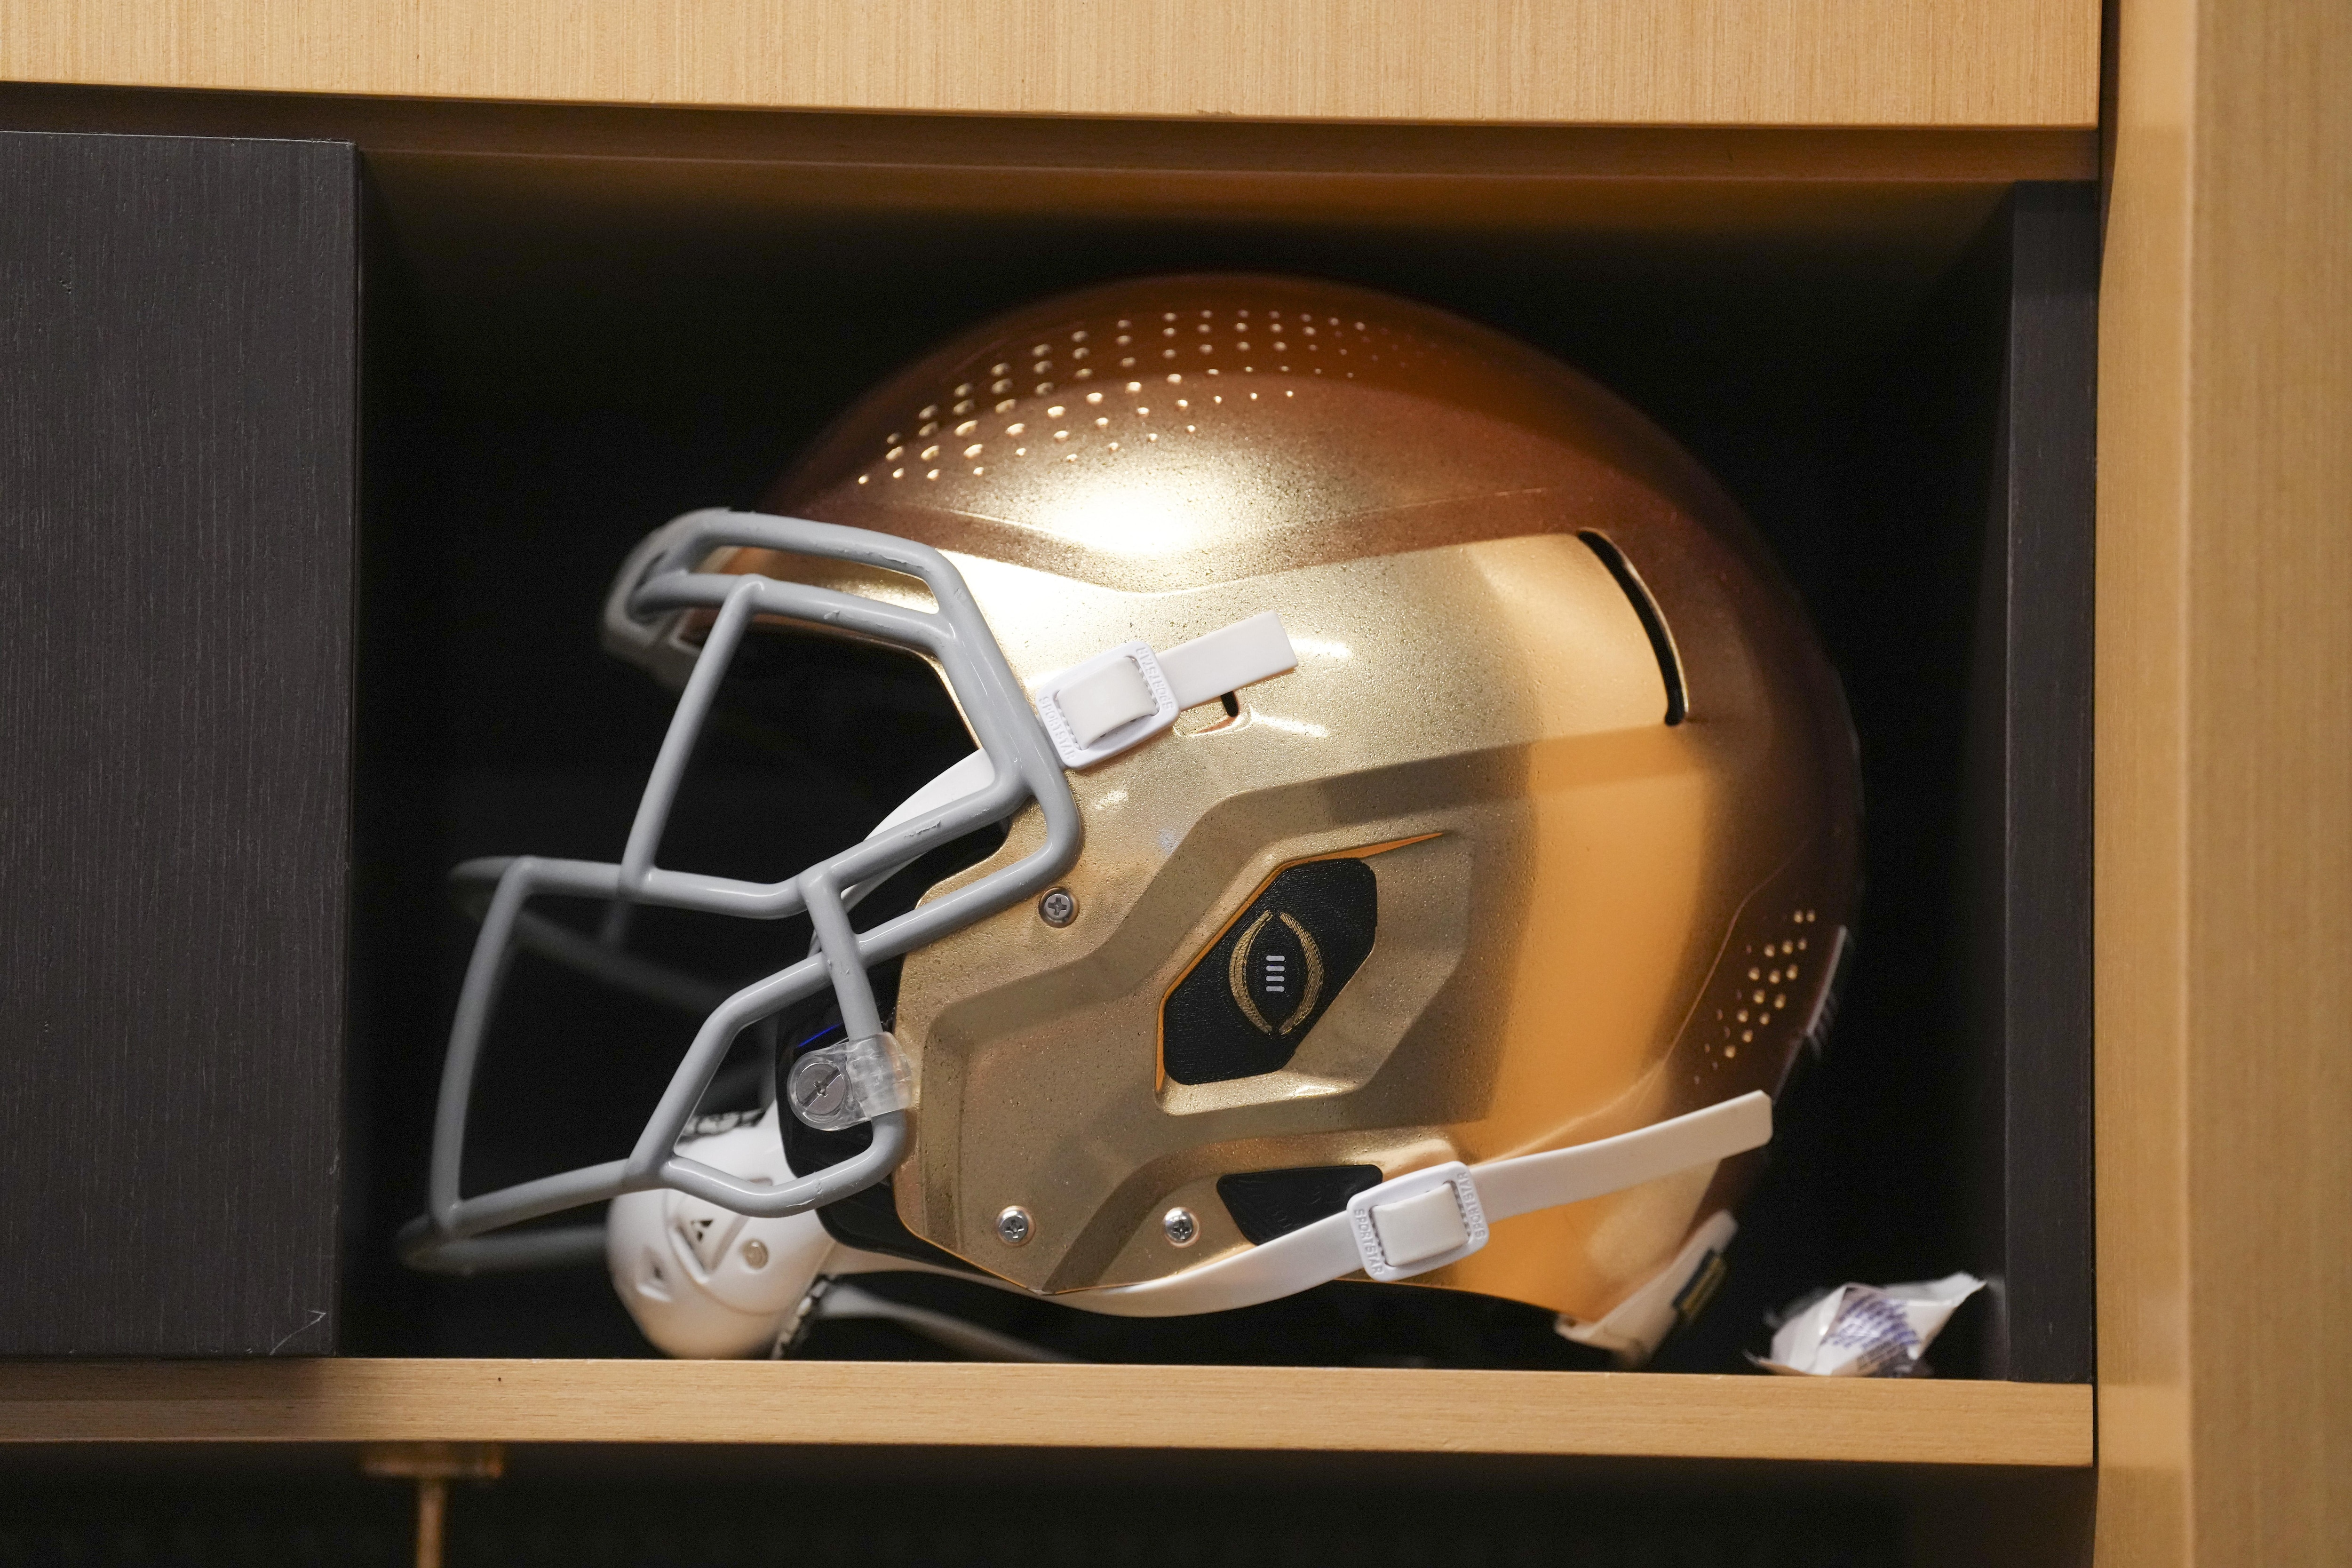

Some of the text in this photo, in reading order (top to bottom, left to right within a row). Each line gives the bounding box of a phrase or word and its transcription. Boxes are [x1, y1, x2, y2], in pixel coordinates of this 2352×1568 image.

[1136, 646, 1175, 710] SPORTSTAR
[1039, 696, 1076, 760] SPORTSTAR
[1459, 1171, 1486, 1239] SPORTSTAR
[1354, 1209, 1384, 1275] SPORTSTAR
